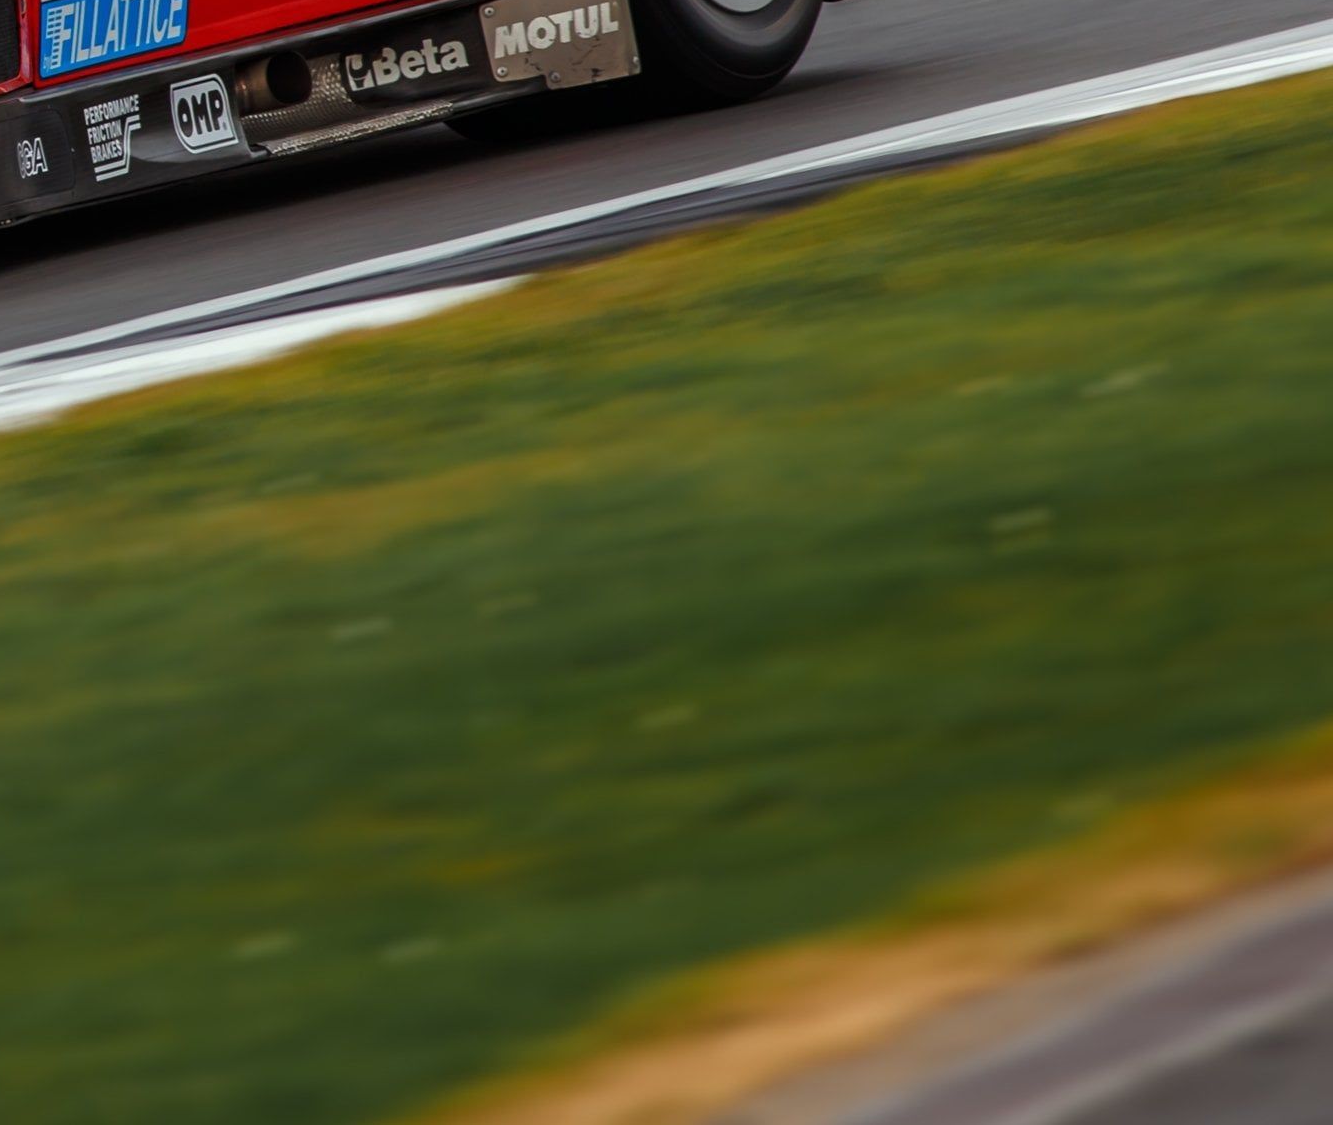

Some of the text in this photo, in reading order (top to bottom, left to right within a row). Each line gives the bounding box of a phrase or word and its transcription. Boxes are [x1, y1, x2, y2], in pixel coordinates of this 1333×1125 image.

[494, 1, 620, 60] MOTUL
[372, 38, 470, 87] Beta
[83, 93, 140, 126] PERFORMANCE
[177, 89, 226, 138] OMP
[87, 120, 123, 146] FRICTION
[90, 138, 124, 164] BRAKES
